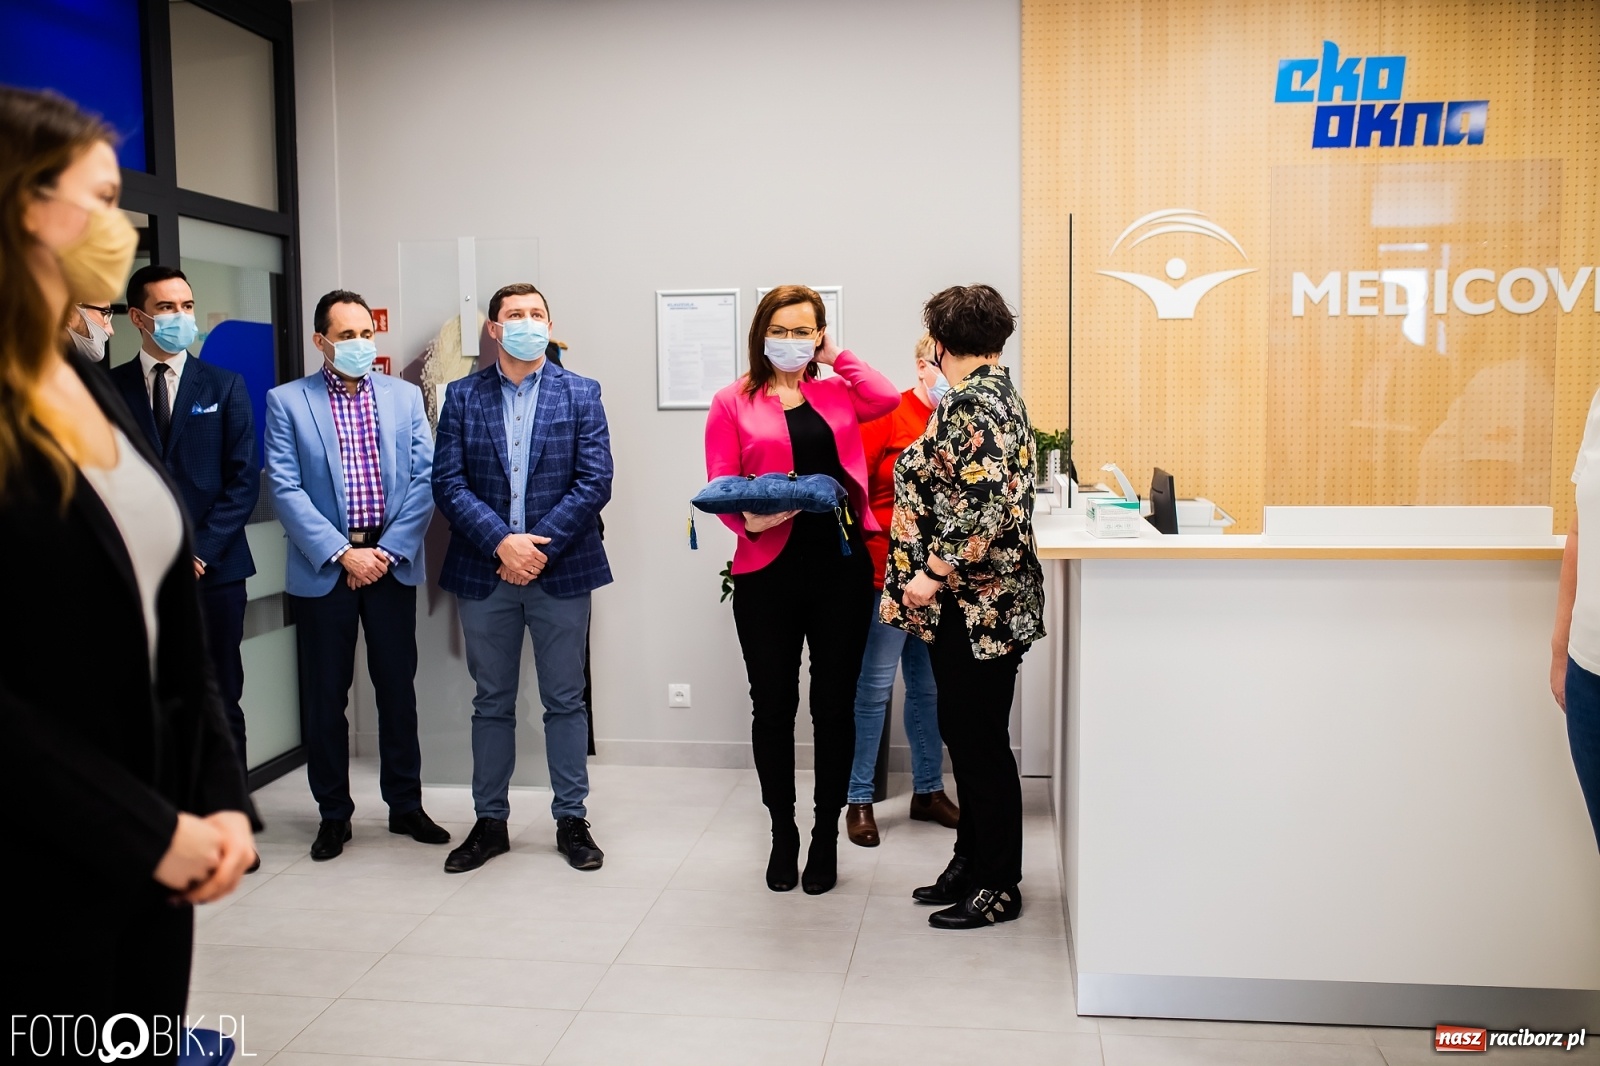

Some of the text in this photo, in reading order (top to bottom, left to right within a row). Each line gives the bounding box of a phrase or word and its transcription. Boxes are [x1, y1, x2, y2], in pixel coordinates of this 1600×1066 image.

[1274, 40, 1407, 103] eko
[1311, 100, 1490, 149] okna
[1291, 267, 1600, 317] MEDICOV
